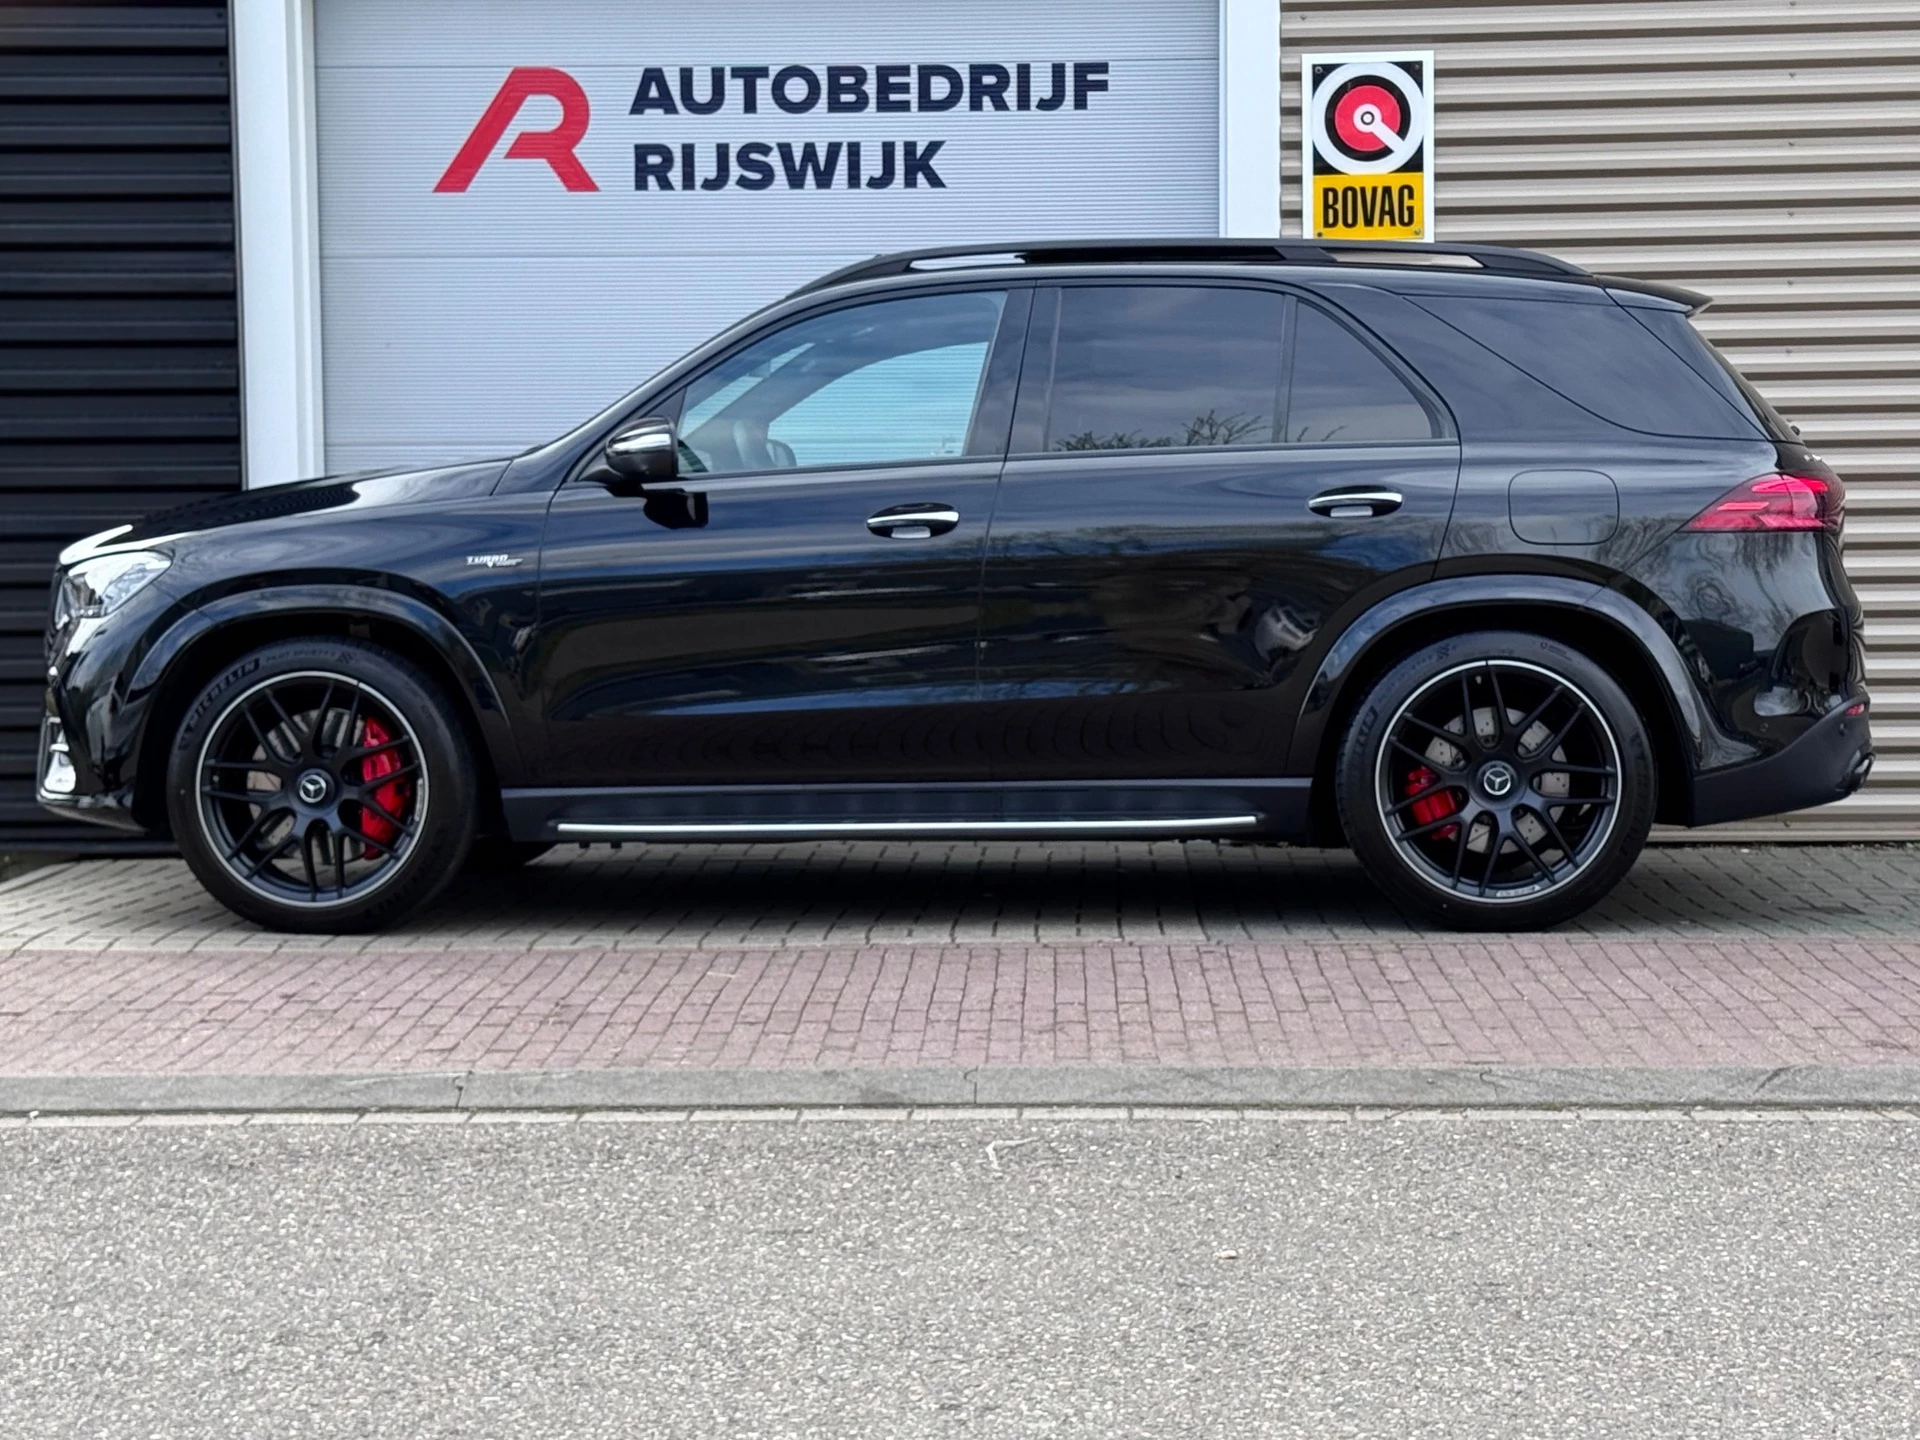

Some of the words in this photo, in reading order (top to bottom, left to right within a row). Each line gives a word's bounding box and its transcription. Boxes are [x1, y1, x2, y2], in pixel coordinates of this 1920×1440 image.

[630, 62, 1109, 115] AUTOBEDRIJF
[634, 141, 947, 190] RIJSWIJK
[1322, 184, 1415, 228] BOVAG
